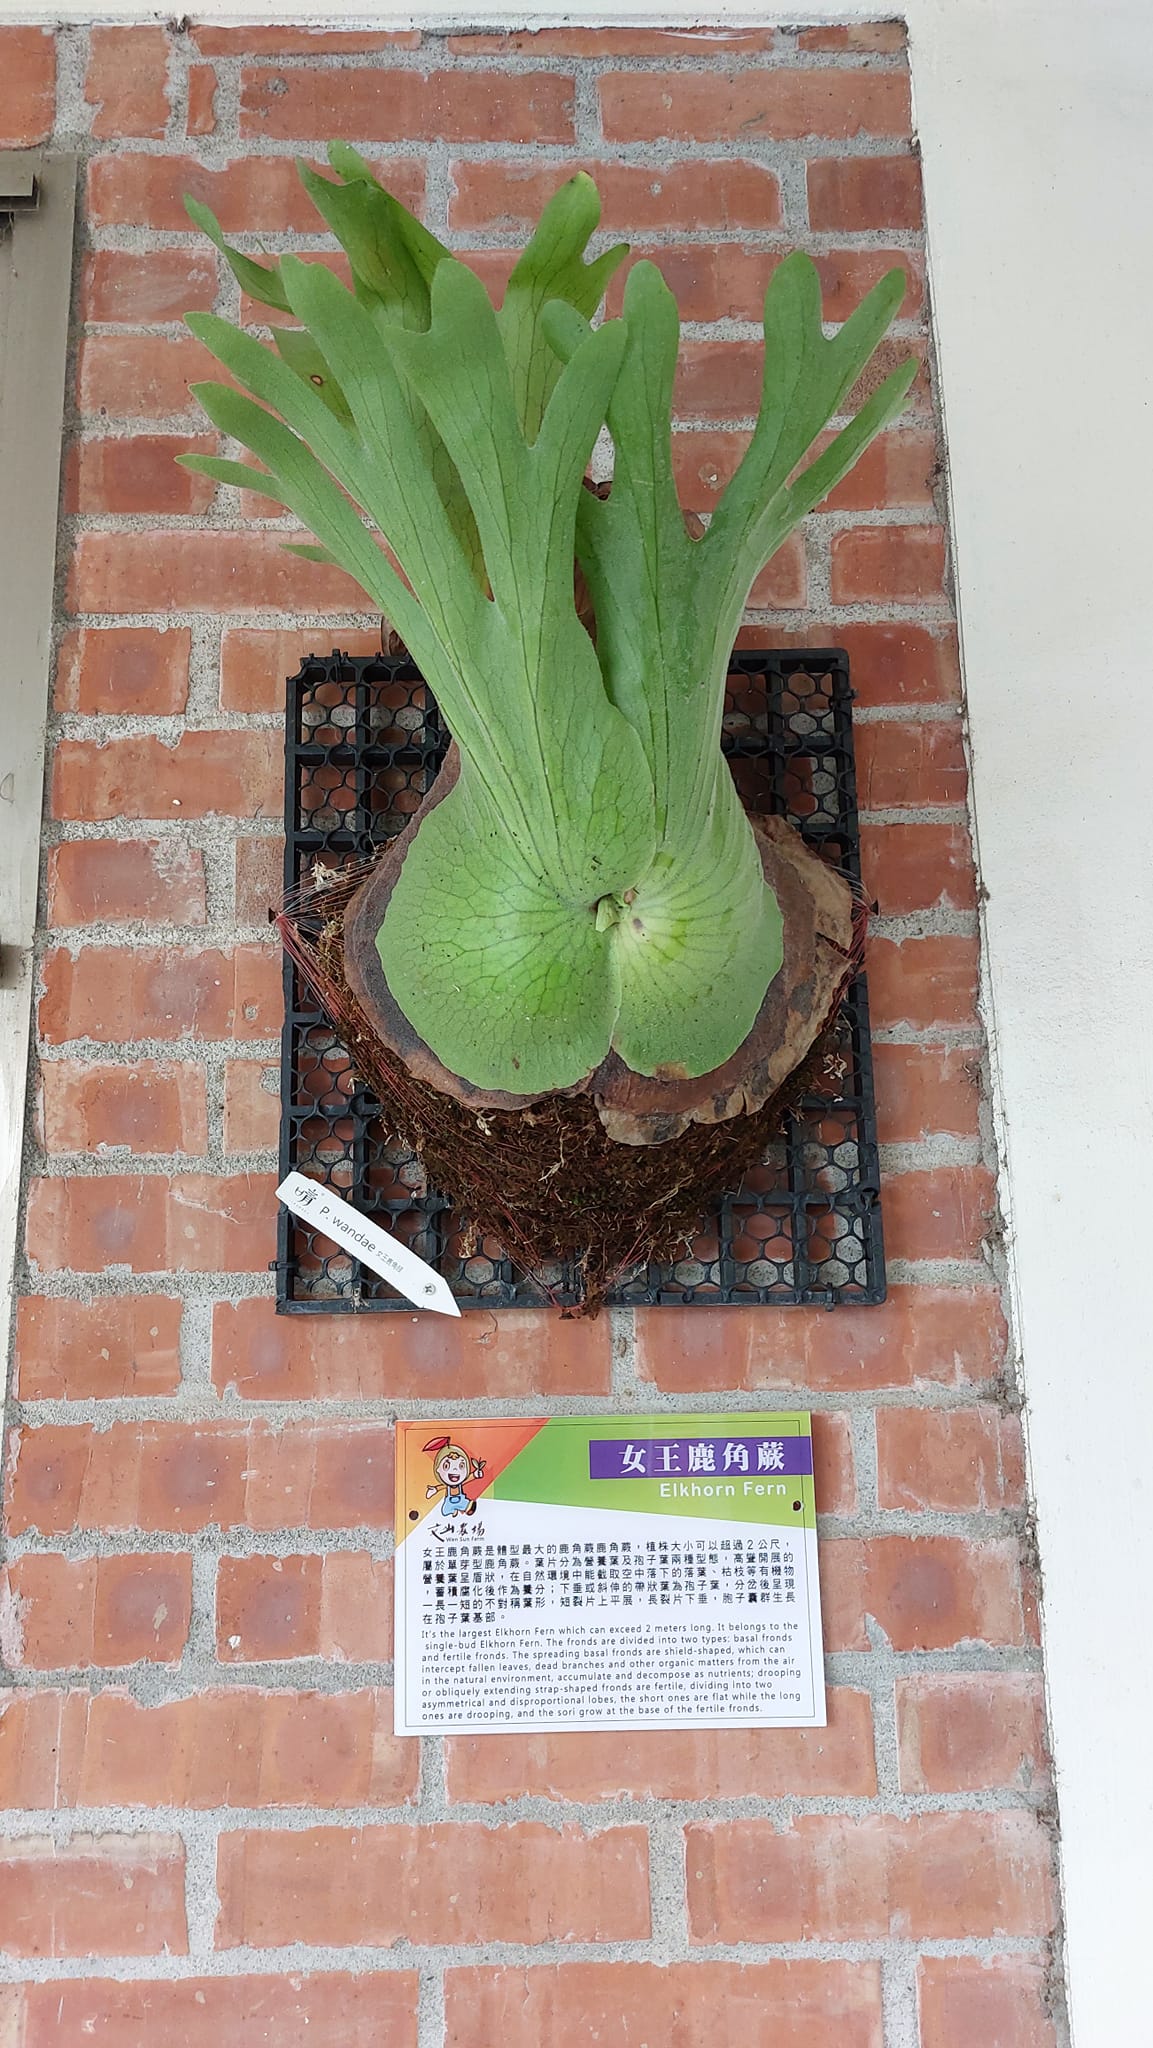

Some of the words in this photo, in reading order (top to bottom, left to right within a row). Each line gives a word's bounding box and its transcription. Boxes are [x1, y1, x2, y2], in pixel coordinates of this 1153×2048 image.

[319, 1206, 330, 1220] P.
[332, 1216, 376, 1252] wandae
[618, 1441, 785, 1474] 女王鹿角蕨
[660, 1482, 735, 1498] Elkhorn
[743, 1481, 787, 1496] Fern
[421, 1629, 436, 1639] It's
[439, 1629, 455, 1638] the
[458, 1628, 491, 1640] largest
[495, 1627, 530, 1637] Elkhorn
[534, 1627, 555, 1636] Fern
[558, 1626, 585, 1636] which
[609, 1625, 641, 1634] exceed
[645, 1624, 651, 1634] 2
[654, 1625, 687, 1633] meters
[690, 1623, 714, 1635] long.
[717, 1623, 725, 1632] It
[728, 1622, 766, 1634] belongs
[769, 1623, 779, 1631] to
[782, 1621, 798, 1631] the
[425, 1639, 476, 1651] single-bud
[480, 1638, 515, 1648] Elkhorn
[519, 1638, 542, 1647] Fern.
[546, 1638, 563, 1647] The
[566, 1637, 597, 1647] fronds
[619, 1636, 654, 1646] divided
[658, 1635, 677, 1645] into
[680, 1636, 698, 1644] two
[701, 1636, 730, 1646] types:
[733, 1634, 758, 1643] basal
[761, 1633, 792, 1643] fronds
[421, 1652, 439, 1662] and
[442, 1652, 471, 1661] fertile
[475, 1651, 508, 1661] fronds.
[512, 1650, 529, 1660] The
[532, 1649, 579, 1661] spreading
[583, 1649, 608, 1658] basal
[612, 1648, 642, 1657] fronds
[664, 1646, 734, 1658] shield-shaped,
[737, 1645, 765, 1655] which
[421, 1663, 465, 1675] intercept
[468, 1663, 495, 1672] fallen
[498, 1662, 531, 1673] leaves,
[534, 1661, 558, 1671] dead
[561, 1660, 604, 1670] branches
[608, 1660, 625, 1669] and
[629, 1659, 655, 1669] other
[658, 1658, 694, 1670] organic
[698, 1658, 734, 1667] matters
[737, 1657, 760, 1666] from
[763, 1656, 779, 1666] the
[782, 1656, 795, 1665] air
[421, 1676, 430, 1685] in
[434, 1675, 449, 1684] the
[453, 1674, 487, 1684] natural
[490, 1673, 553, 1684] environment,
[557, 1672, 612, 1682] accumulate
[614, 1671, 632, 1681] and
[636, 1670, 690, 1682] decompose
[707, 1669, 753, 1680] nutrients;
[757, 1668, 801, 1680] drooping
[435, 1686, 480, 1698] obliquely
[483, 1685, 531, 1697] extending
[534, 1684, 597, 1696] strap-shaped
[601, 1683, 632, 1693] fronds
[654, 1682, 686, 1693] fertile,
[689, 1681, 728, 1693] dividing
[754, 1681, 772, 1690] two
[421, 1698, 485, 1710] asymmetrical
[488, 1697, 506, 1707] and
[509, 1696, 584, 1709] disproportional
[588, 1695, 616, 1706] lobes,
[620, 1695, 635, 1704] the
[639, 1694, 664, 1704] short
[712, 1693, 728, 1702] flat
[731, 1692, 757, 1702] while
[760, 1692, 775, 1701] the
[779, 1691, 800, 1703] long
[466, 1709, 513, 1721] drooping,
[517, 1708, 534, 1718] and
[538, 1708, 554, 1717] the
[557, 1707, 575, 1717] sori
[578, 1709, 603, 1719] grow
[606, 1708, 615, 1716] at
[619, 1706, 634, 1716] the
[638, 1706, 660, 1715] base
[663, 1705, 673, 1715] of
[676, 1705, 692, 1714] the
[696, 1704, 725, 1714] fertile
[728, 1704, 762, 1713] fronds.
